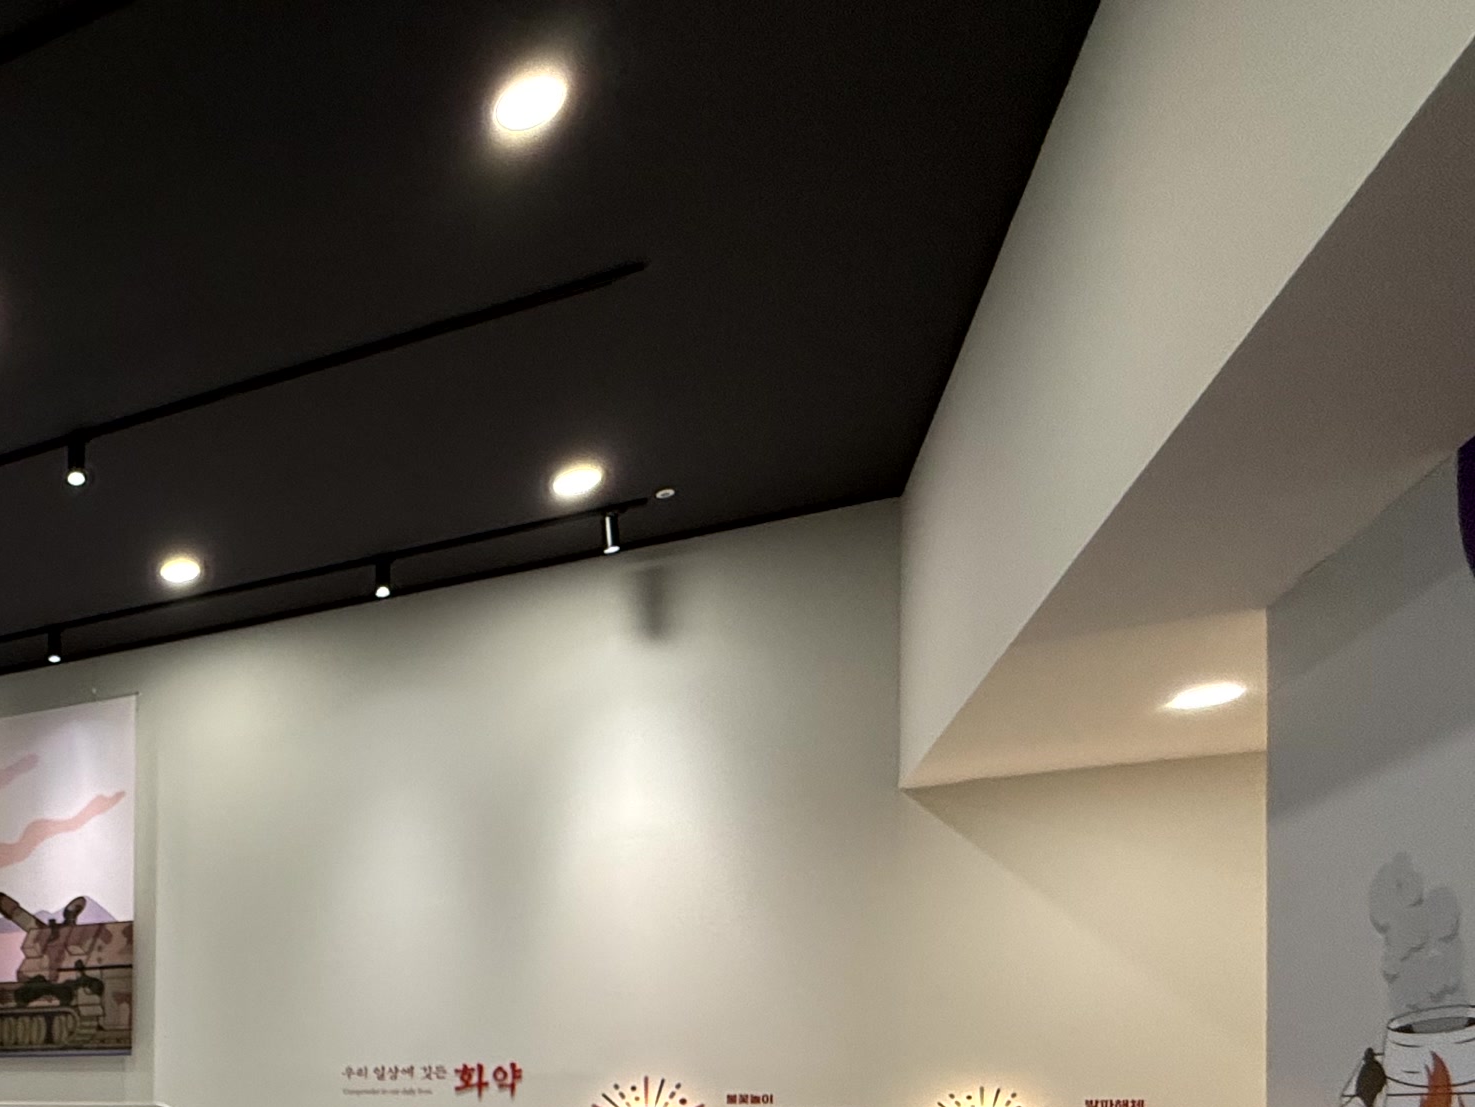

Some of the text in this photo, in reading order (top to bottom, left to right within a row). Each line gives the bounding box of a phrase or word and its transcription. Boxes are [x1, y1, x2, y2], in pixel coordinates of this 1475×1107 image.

[342, 1062, 522, 1101] 우리 일상에 깃든 화약
[727, 1094, 773, 1104] 불꽃놀이
